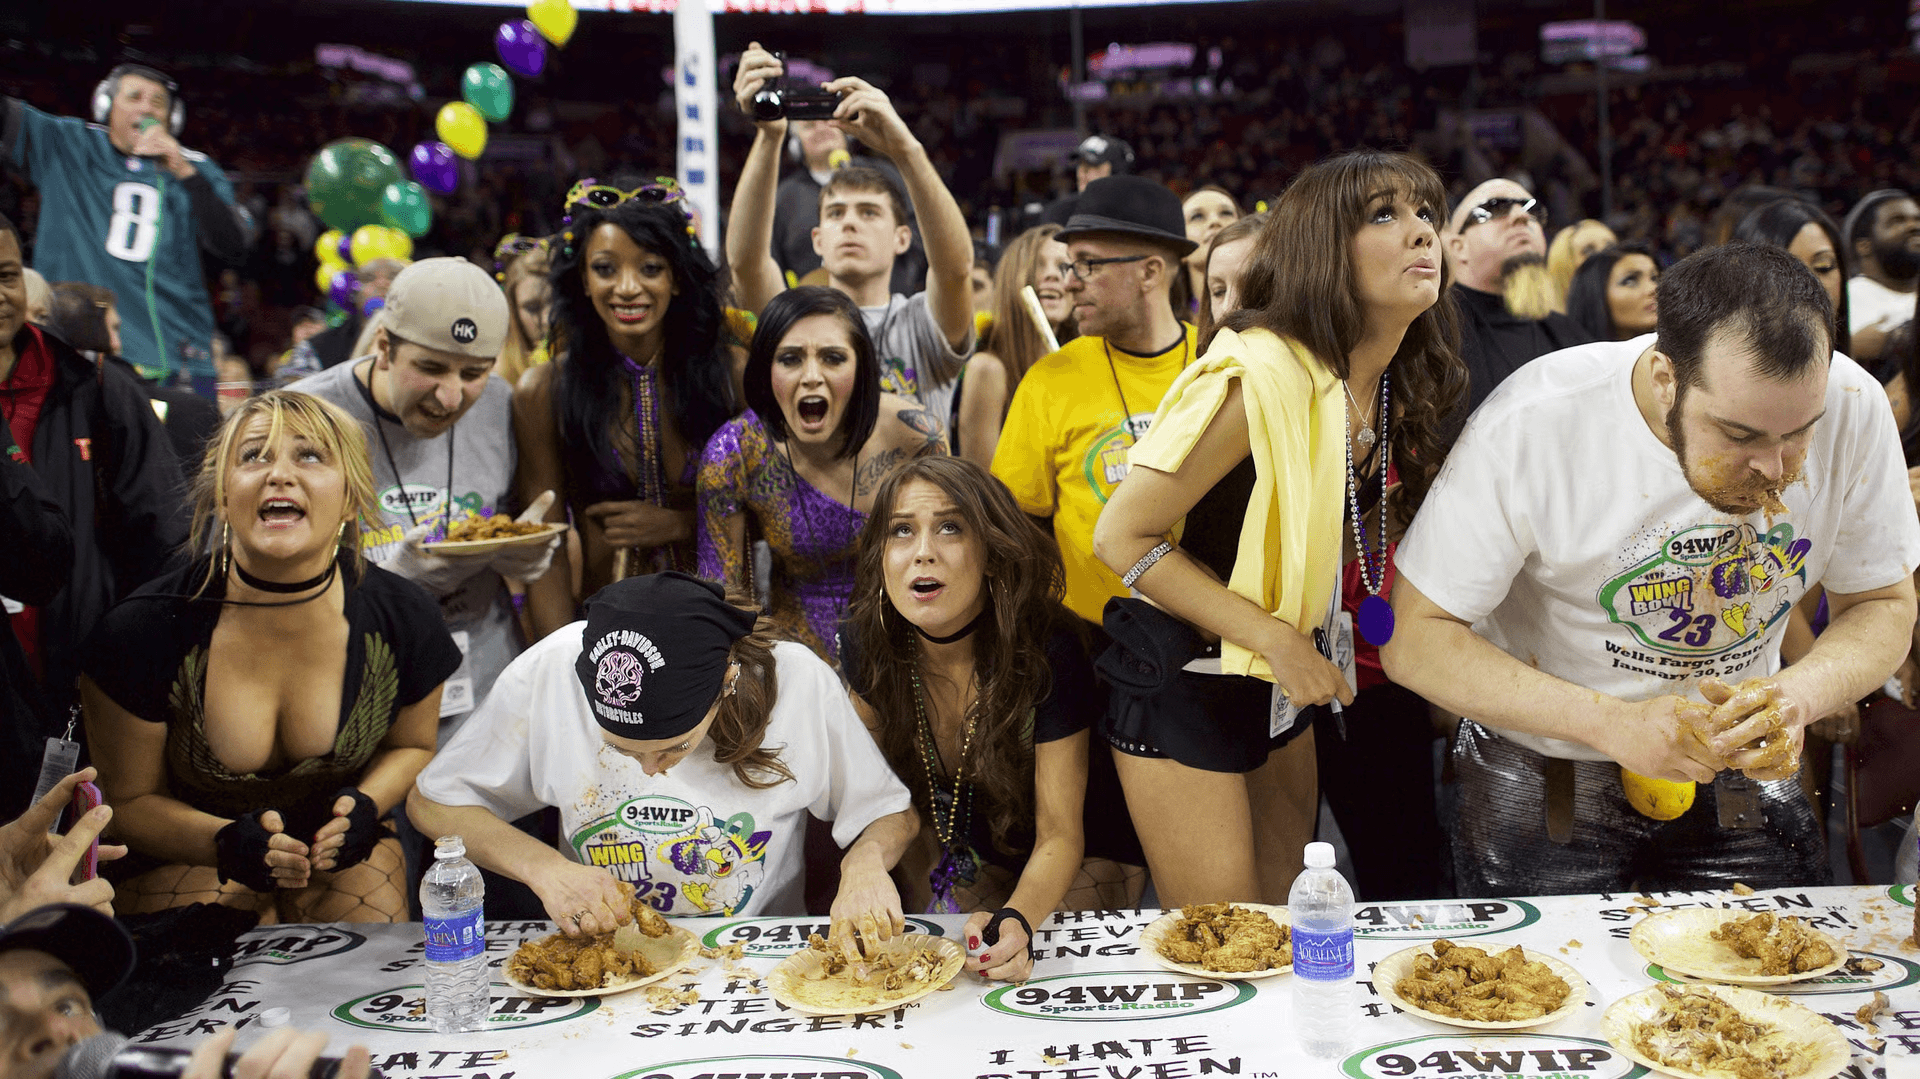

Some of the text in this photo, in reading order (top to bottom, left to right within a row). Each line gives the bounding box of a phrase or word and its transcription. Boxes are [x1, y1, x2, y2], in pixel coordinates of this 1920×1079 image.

[105, 181, 160, 262] 8
[454, 323, 475, 339] HK
[1671, 530, 1736, 555] 94WIP
[1630, 578, 1691, 602] WING
[1632, 592, 1694, 616] BOWL
[1657, 608, 1717, 647] 23
[1604, 640, 1656, 664] Wells
[1658, 656, 1715, 669] Fargo
[1611, 657, 1691, 682] January
[1693, 668, 1721, 678] 30,
[626, 806, 694, 822] 94WIP
[634, 819, 683, 829] SportsRadio
[587, 841, 646, 866] WING
[608, 861, 653, 883] OWL
[633, 880, 678, 913] 23
[1354, 902, 1509, 926] 4WIP
[1015, 982, 1224, 1006] 94WIP
[1039, 1000, 1195, 1014] SportsRadio
[630, 1008, 904, 1038] SINGER!
[370, 1050, 510, 1071] ATE
[989, 1035, 1217, 1065] I HATE
[976, 1057, 1241, 1079] TEVEN
[1376, 1049, 1612, 1076] 94WIP
